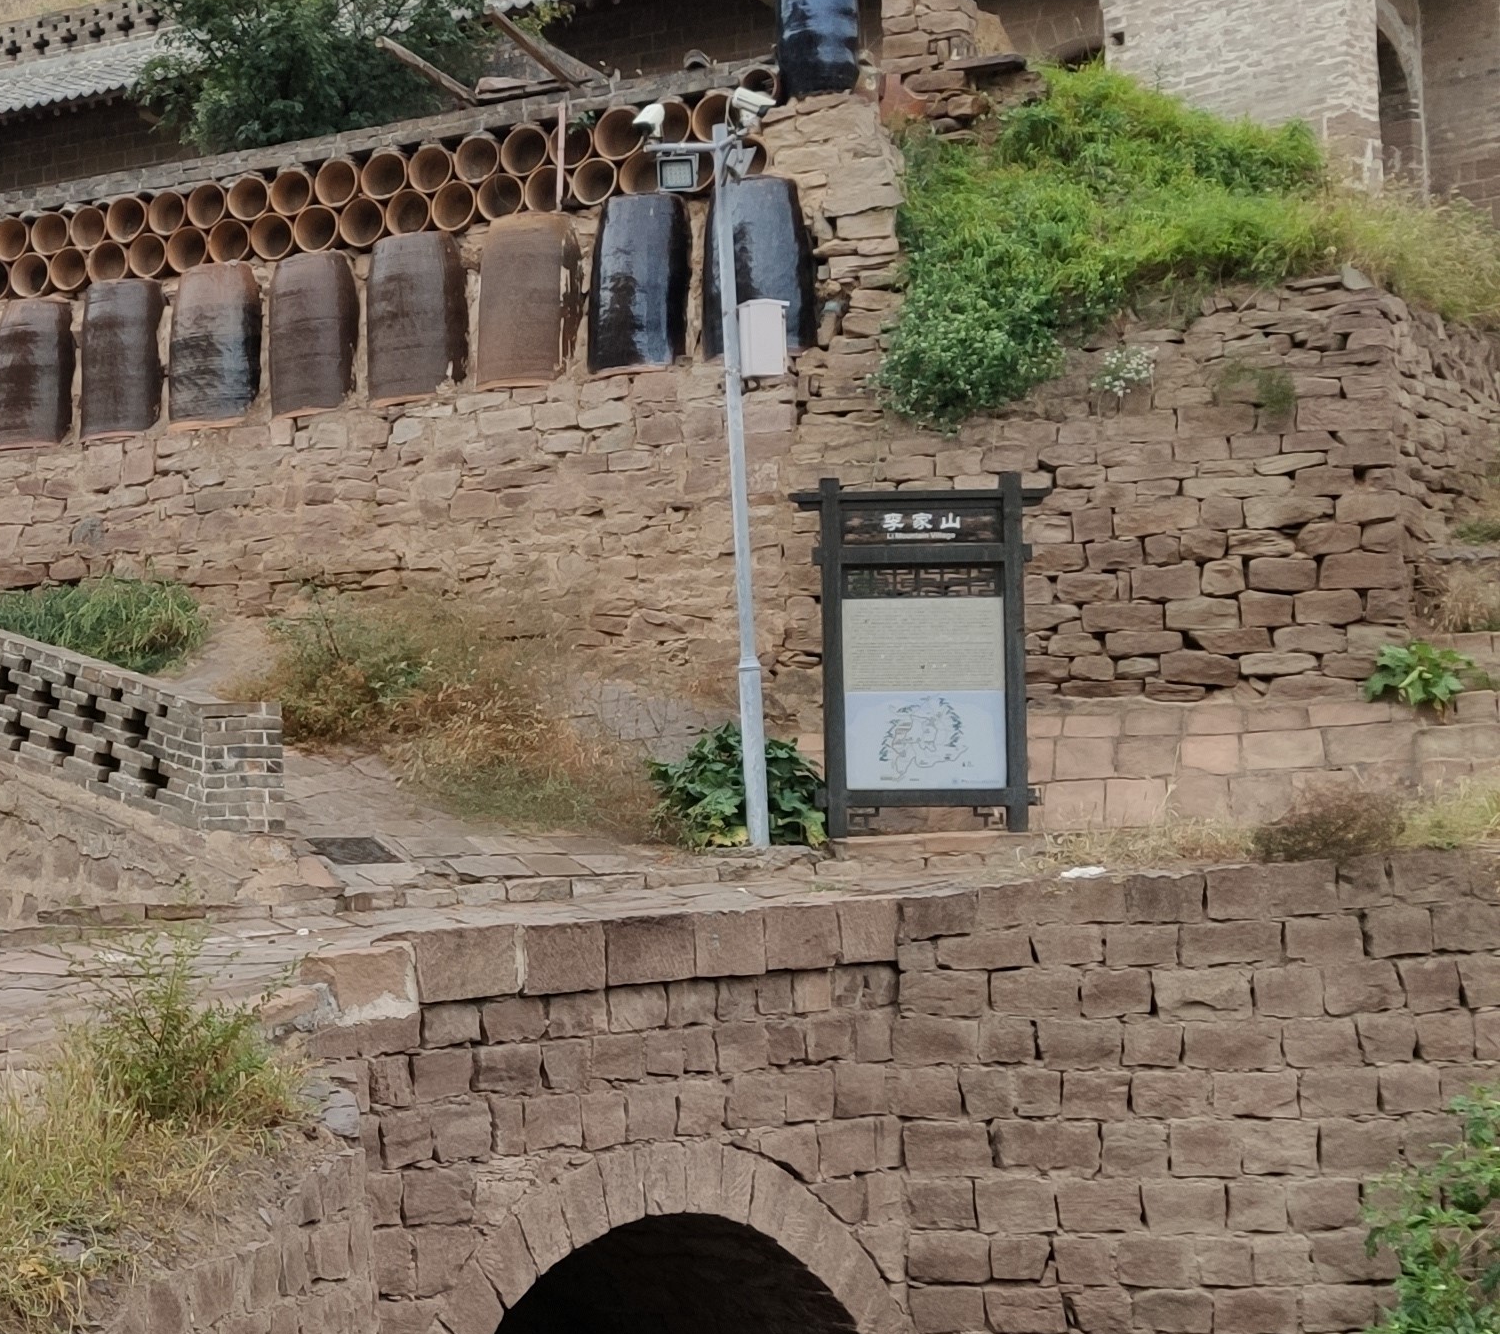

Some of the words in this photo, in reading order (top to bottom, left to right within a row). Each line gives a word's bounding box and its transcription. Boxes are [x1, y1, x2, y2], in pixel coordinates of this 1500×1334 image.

[882, 511, 961, 531] 李家山
[930, 531, 957, 541] Village
